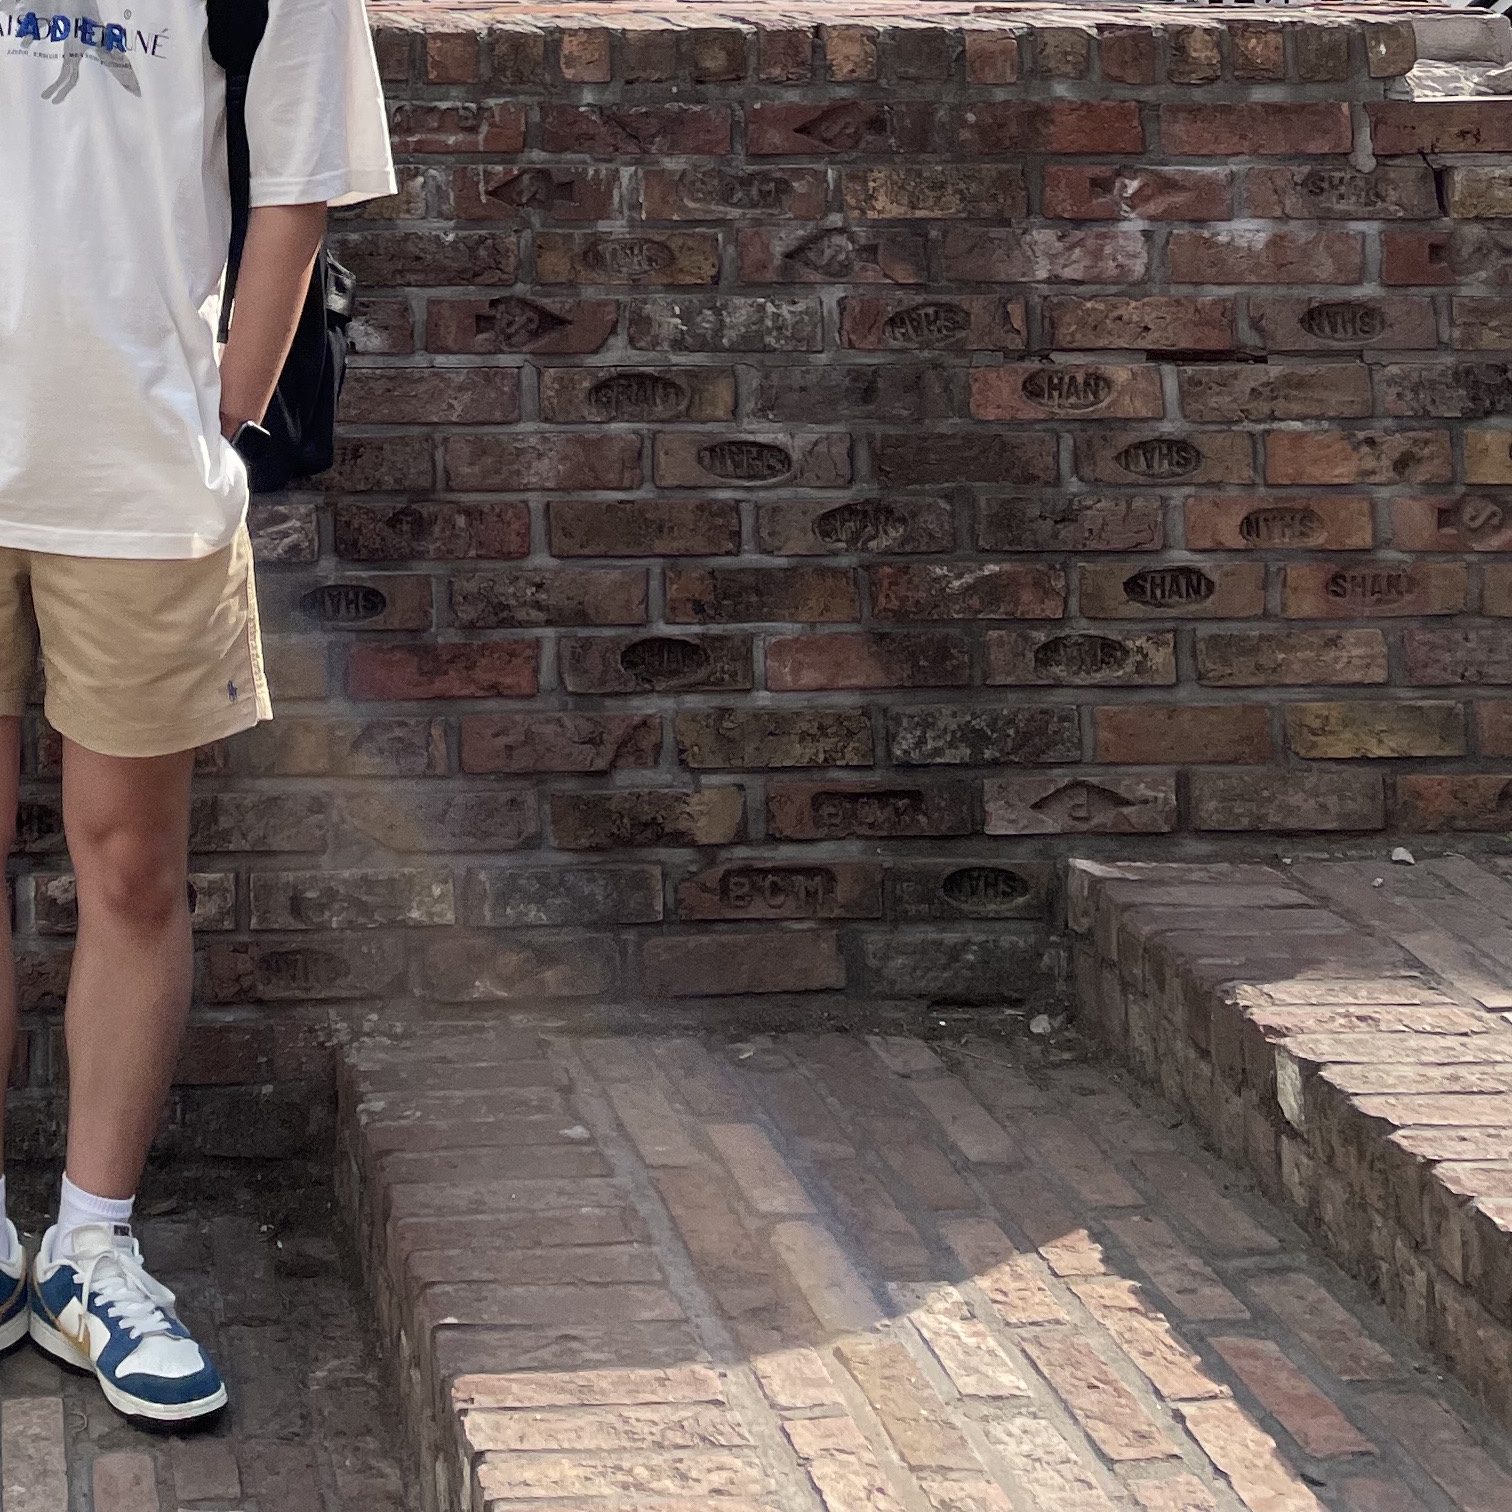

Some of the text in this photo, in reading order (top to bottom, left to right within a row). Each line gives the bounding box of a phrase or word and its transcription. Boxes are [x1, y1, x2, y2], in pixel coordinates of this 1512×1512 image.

[15, 11, 126, 53] ADER
[1023, 368, 1104, 402] SHAN
[1122, 440, 1199, 470] SHAN
[1242, 508, 1320, 542] SHAN
[1135, 571, 1214, 601] SHAN
[1329, 571, 1410, 601] SHAN
[728, 872, 826, 911] BCM
